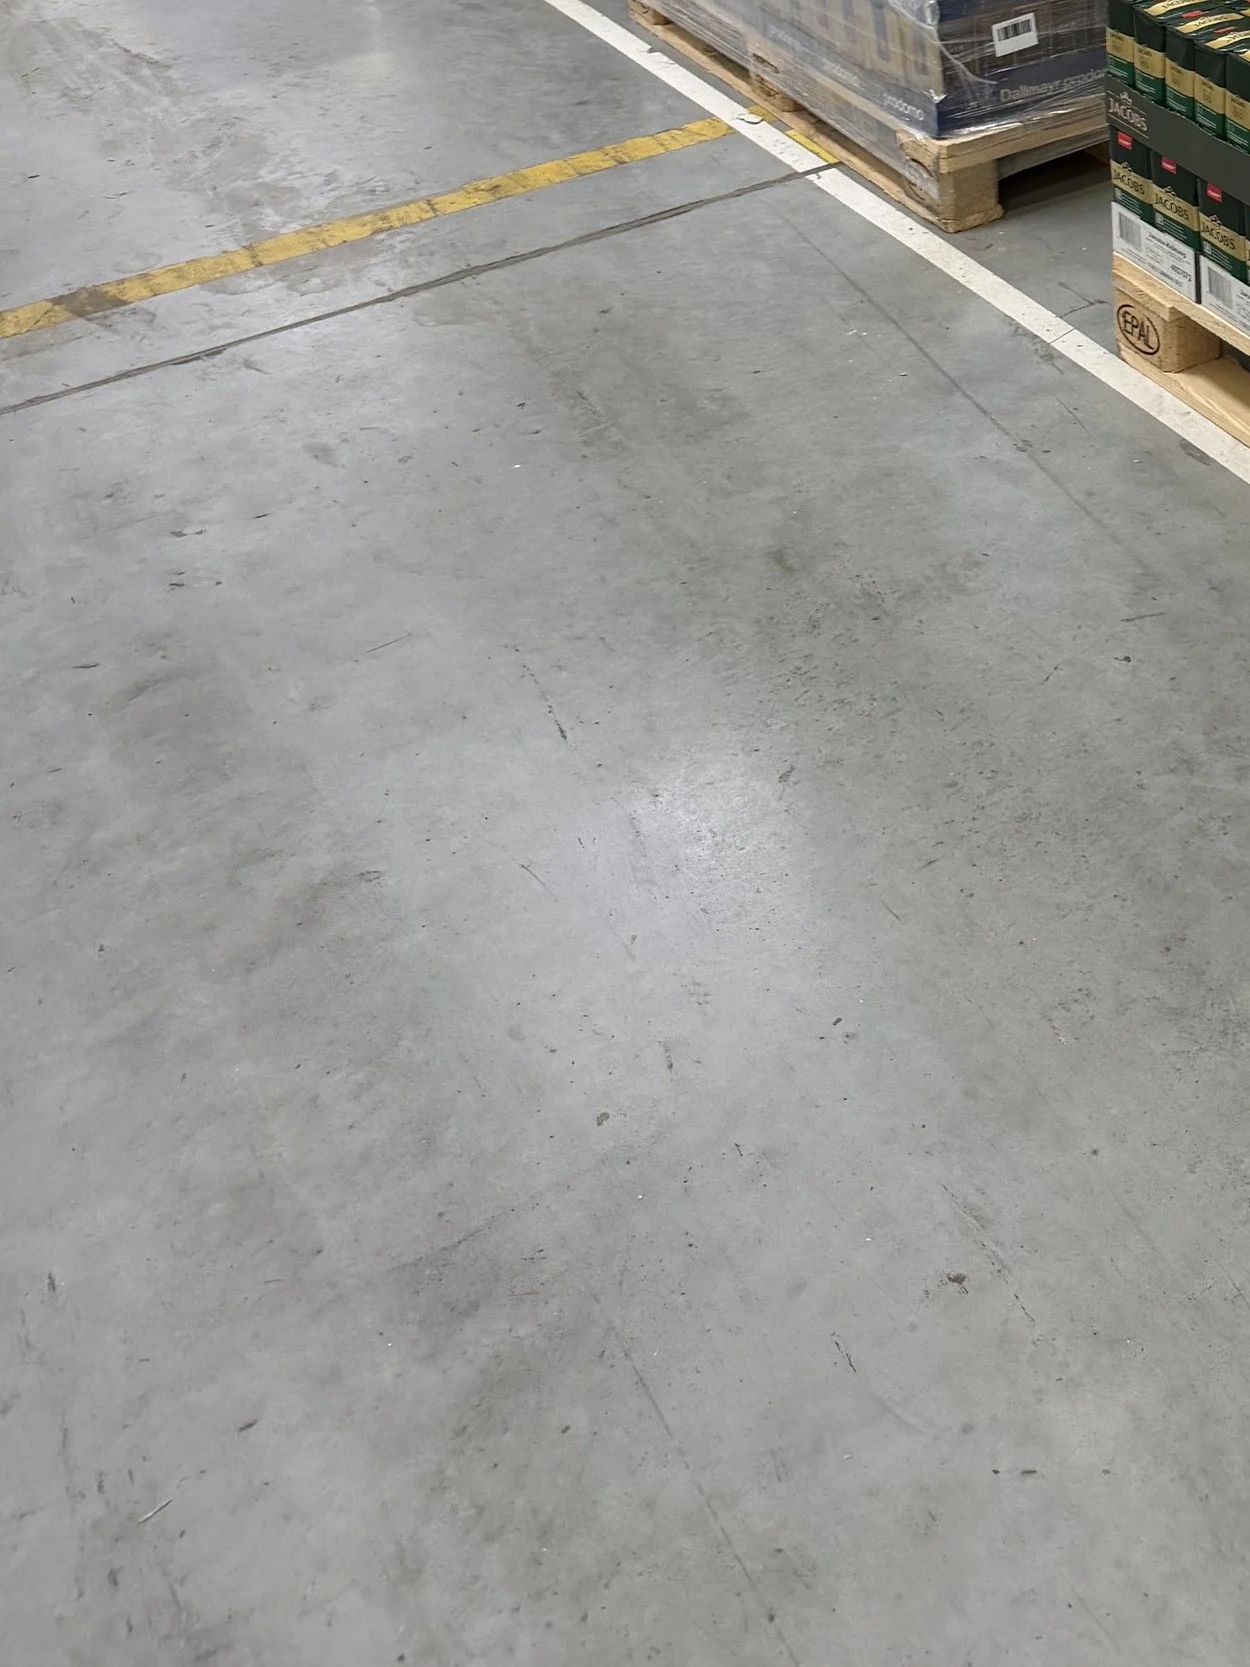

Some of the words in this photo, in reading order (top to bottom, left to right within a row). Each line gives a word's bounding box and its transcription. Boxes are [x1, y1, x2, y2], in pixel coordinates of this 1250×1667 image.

[1108, 102, 1149, 132] JACOBS
[1113, 168, 1145, 195] JACOBS
[1154, 193, 1190, 220] JACOBS
[1201, 221, 1236, 250] JACOBS
[1120, 308, 1152, 353] EPAL
